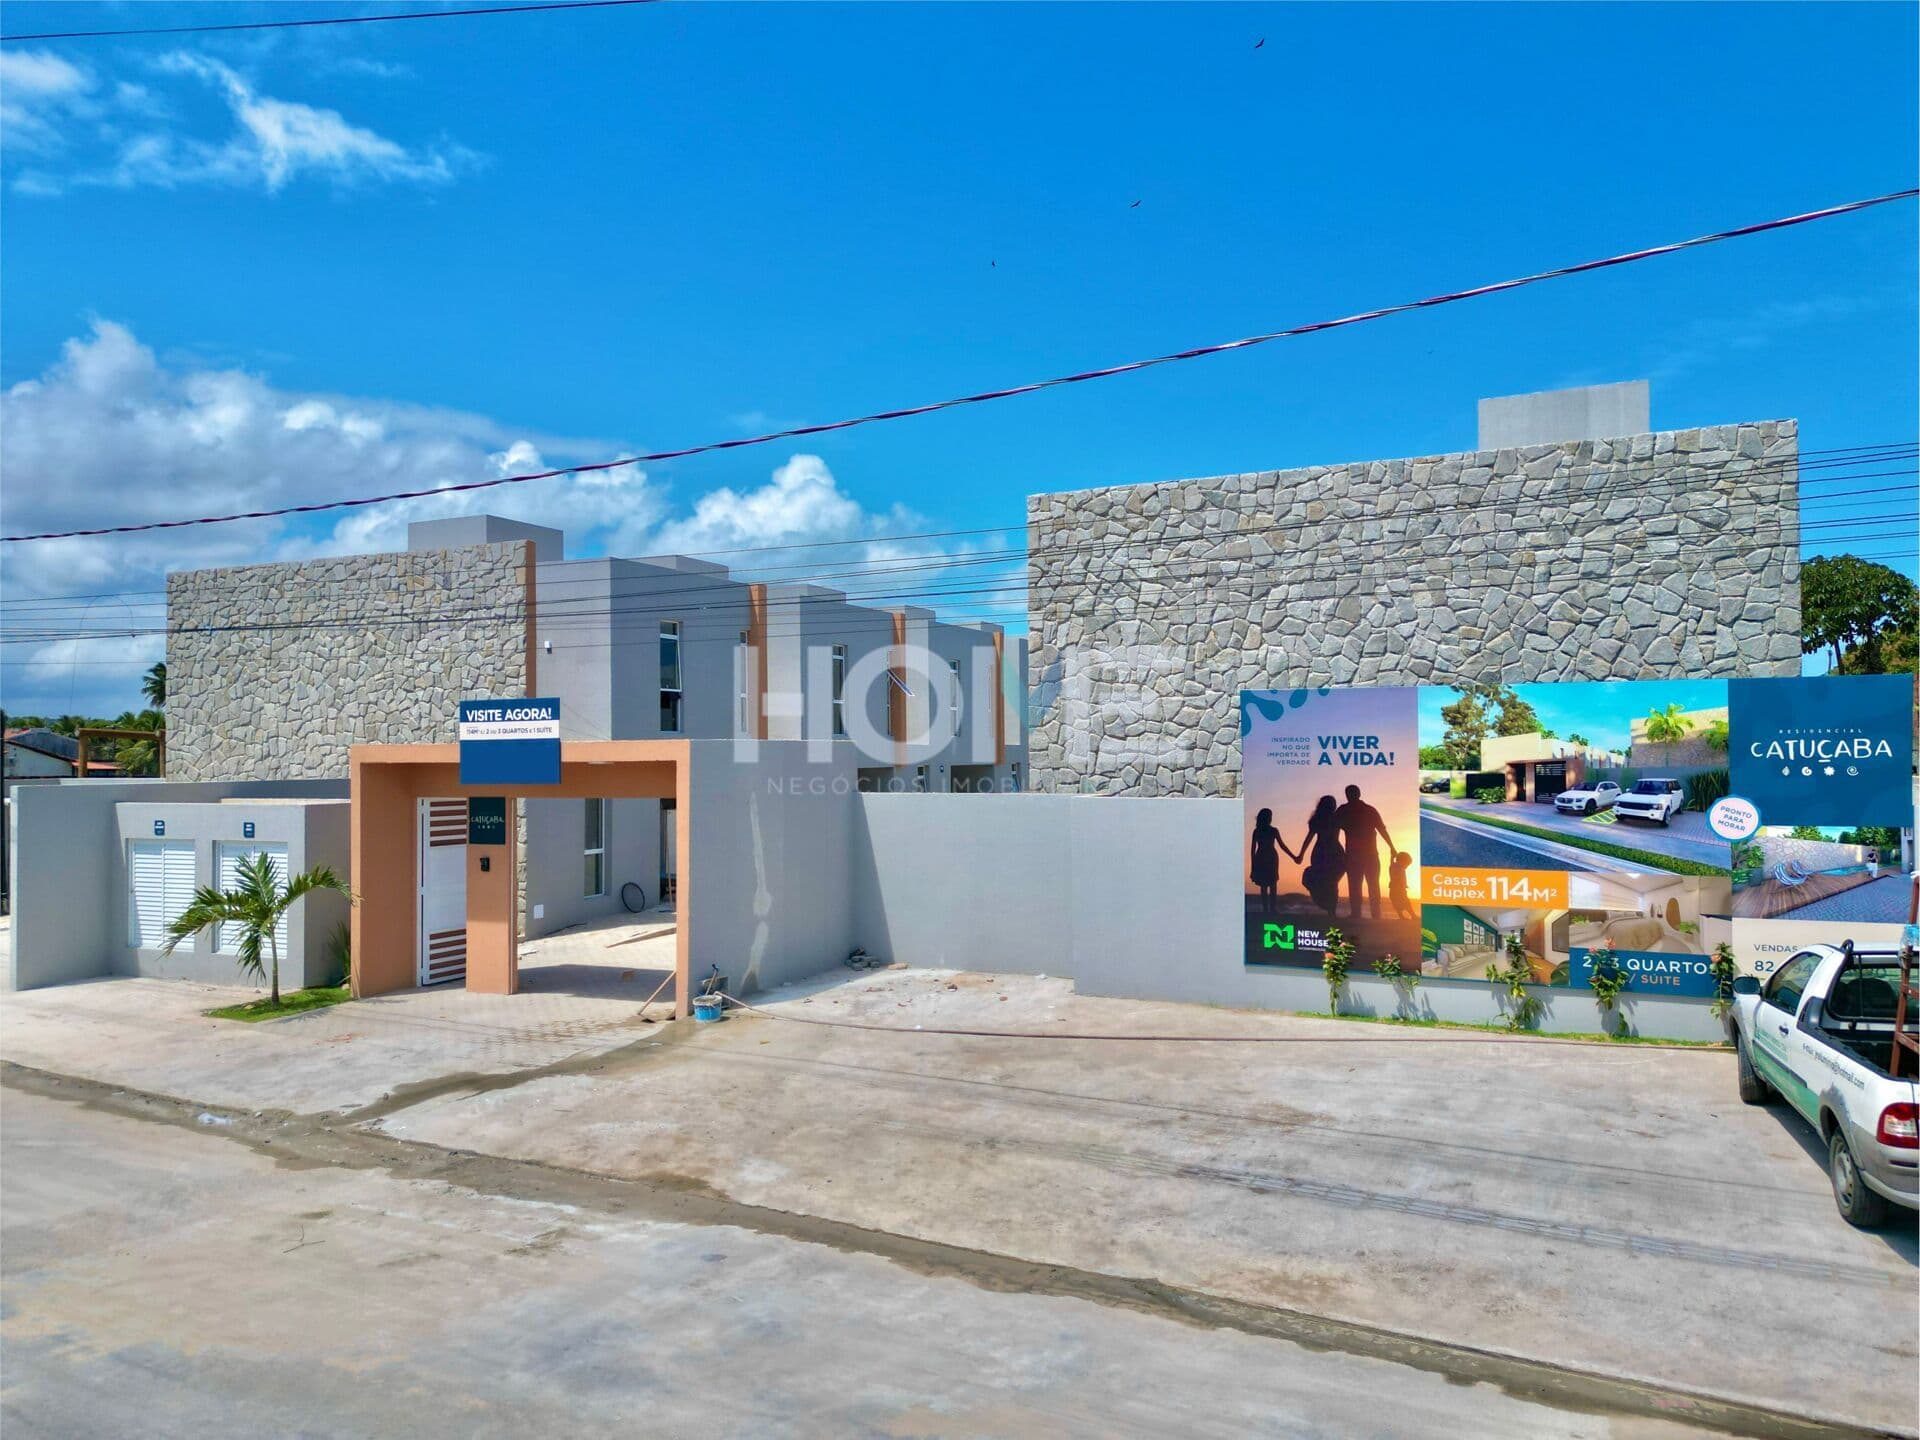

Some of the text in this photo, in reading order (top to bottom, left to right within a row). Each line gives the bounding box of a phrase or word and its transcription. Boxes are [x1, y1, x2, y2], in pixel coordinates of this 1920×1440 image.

[466, 707, 552, 721] VISITE AGORA!
[1317, 735, 1379, 750] VIVER
[1750, 738, 1893, 763] CATUÇABA
[1317, 752, 1394, 766] A VIDA!
[1720, 805, 1753, 819] PRONTO
[1723, 813, 1744, 824] PARA
[1717, 819, 1746, 832] MORAR
[1432, 873, 1478, 886] Casas
[1432, 886, 1485, 899] duplex
[1297, 930, 1320, 938] NEW
[1297, 938, 1329, 947] HOUSE
[1753, 944, 1799, 953] VENDAS
[1582, 956, 1592, 968] 2
[1626, 958, 1718, 975] QUARTO
[1754, 960, 1775, 972] 82
